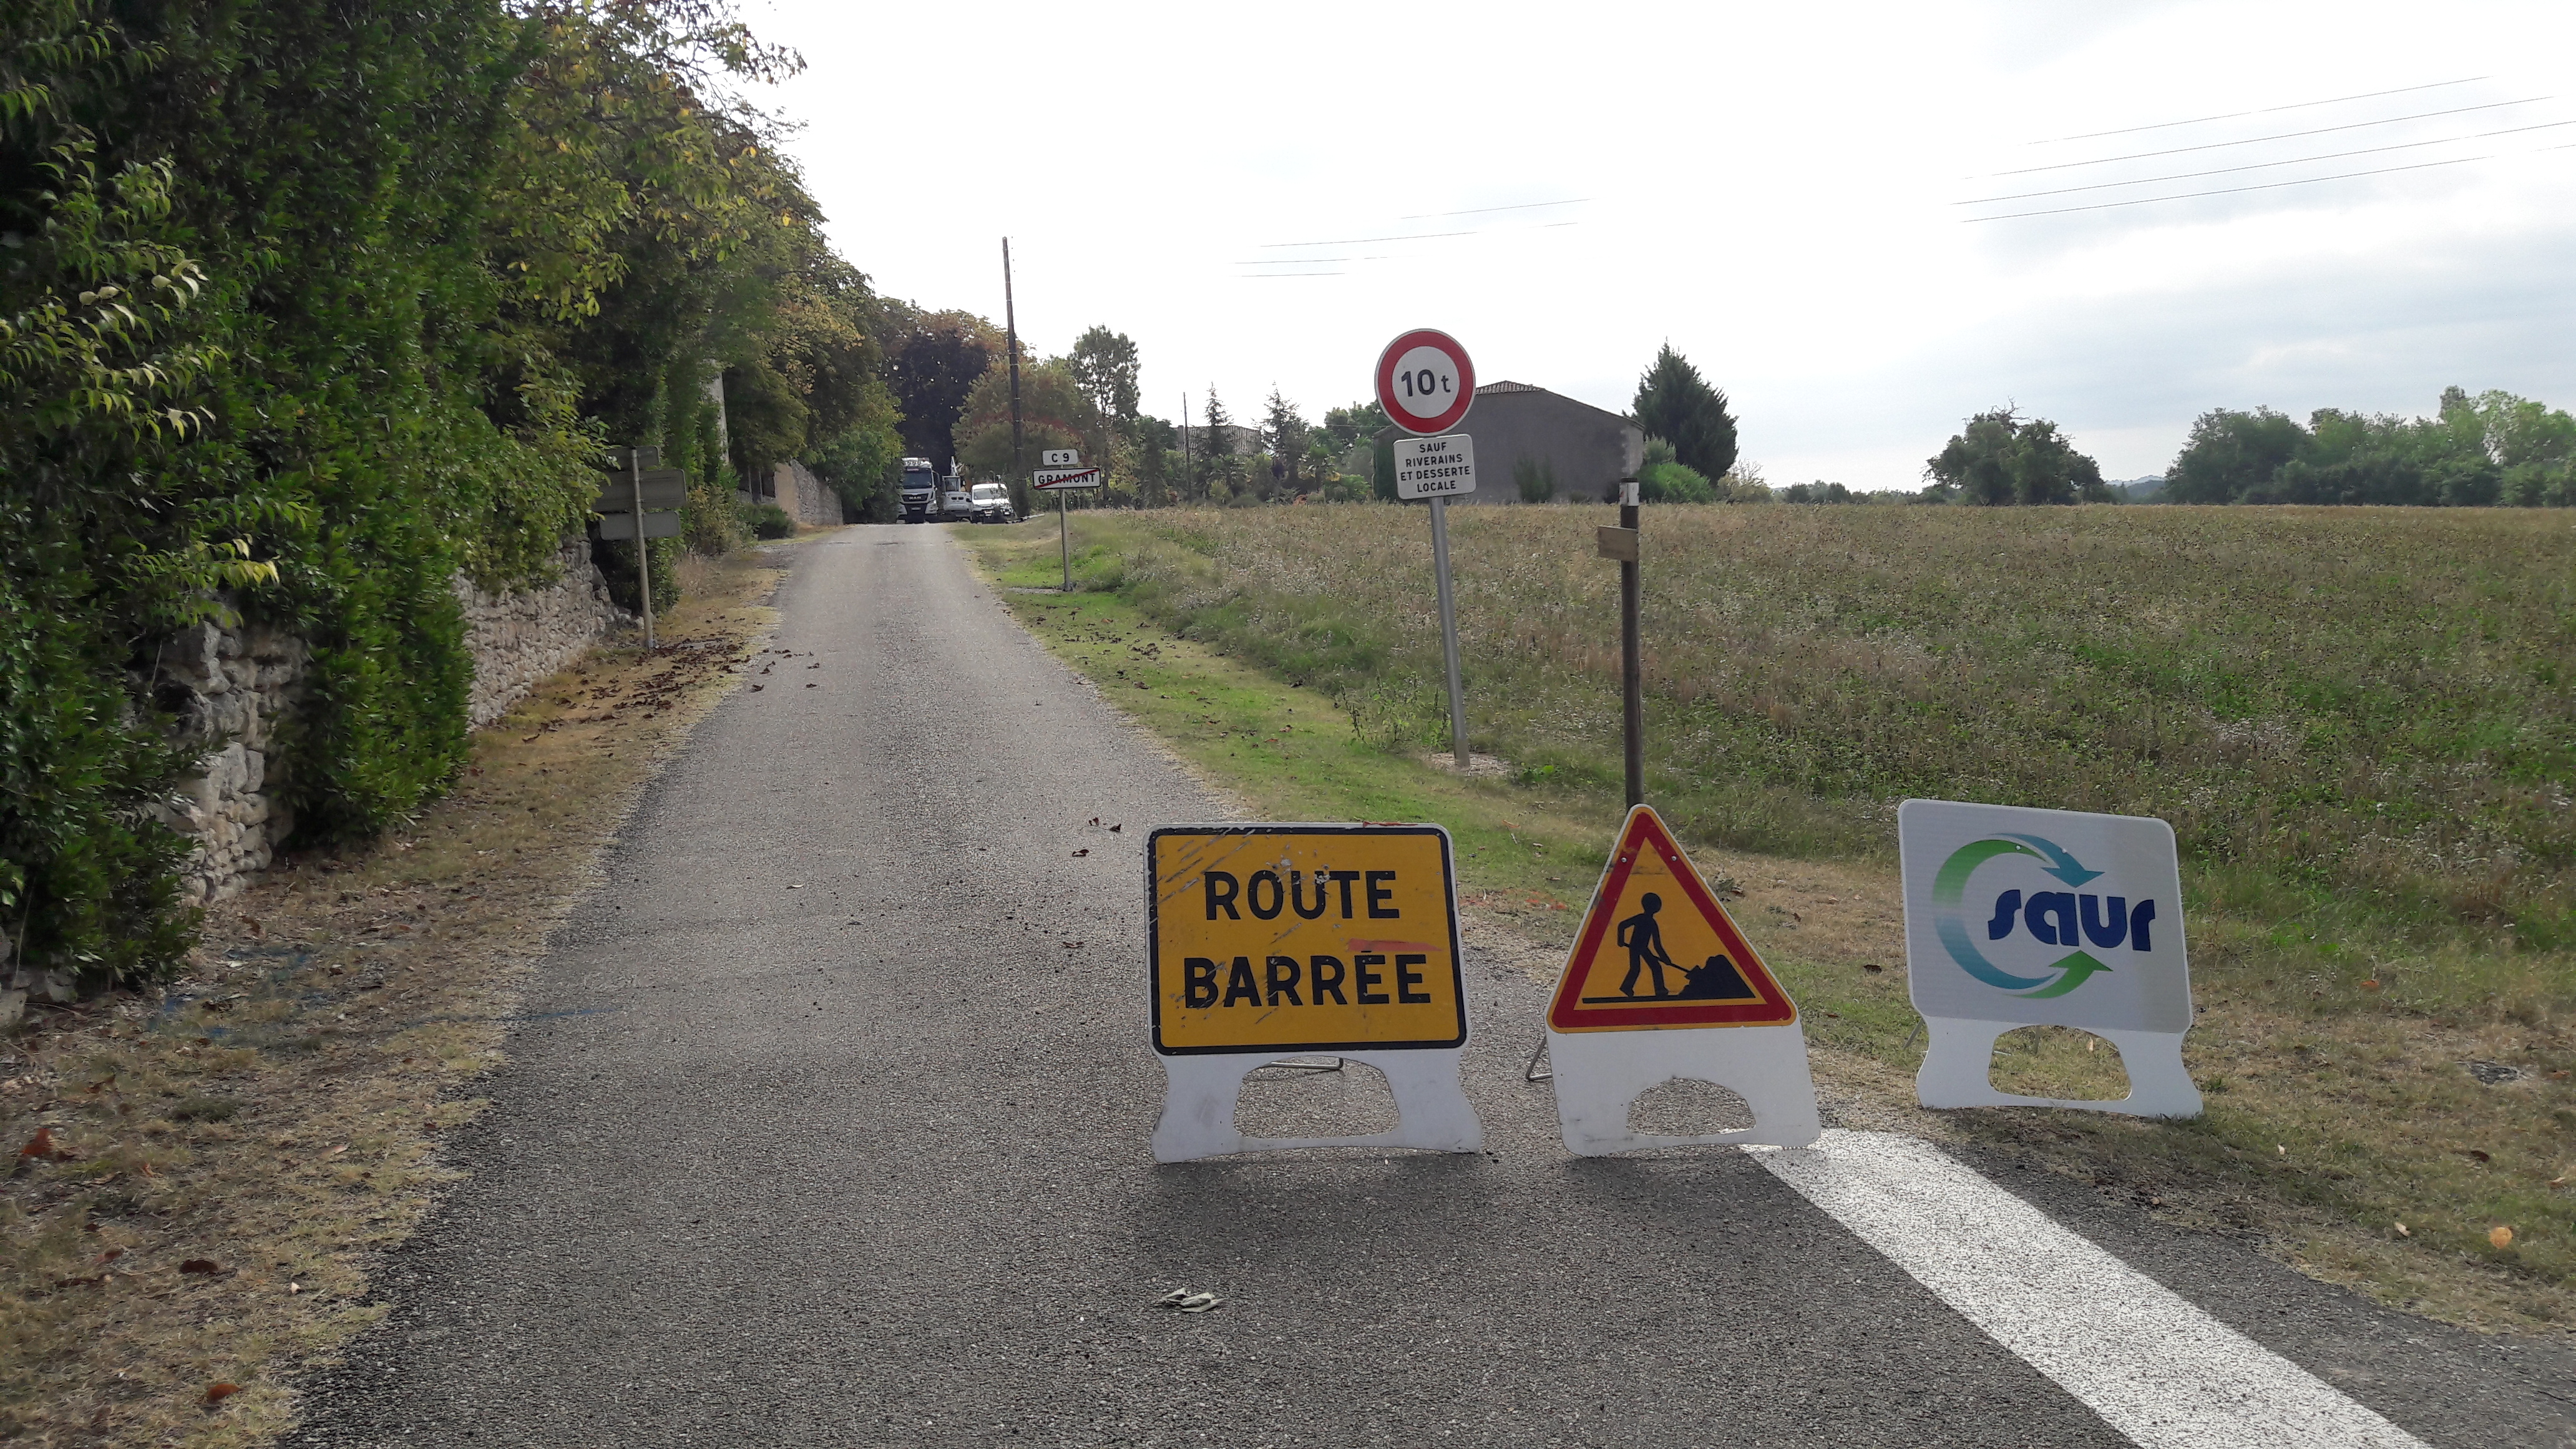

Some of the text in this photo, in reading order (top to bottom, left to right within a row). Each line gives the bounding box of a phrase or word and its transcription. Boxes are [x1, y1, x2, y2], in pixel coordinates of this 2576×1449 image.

[1402, 369, 1451, 397] 10 t
[1420, 442, 1447, 452] SAUF
[1051, 453, 1069, 462] C 9
[1405, 454, 1463, 467] RIVERAINS
[1038, 473, 1095, 484] GRAMONT
[1400, 466, 1470, 481] ET DESSERTE
[1417, 481, 1456, 492] LOCALE
[1204, 870, 1400, 920] ROUTE
[1988, 889, 2156, 952] saur
